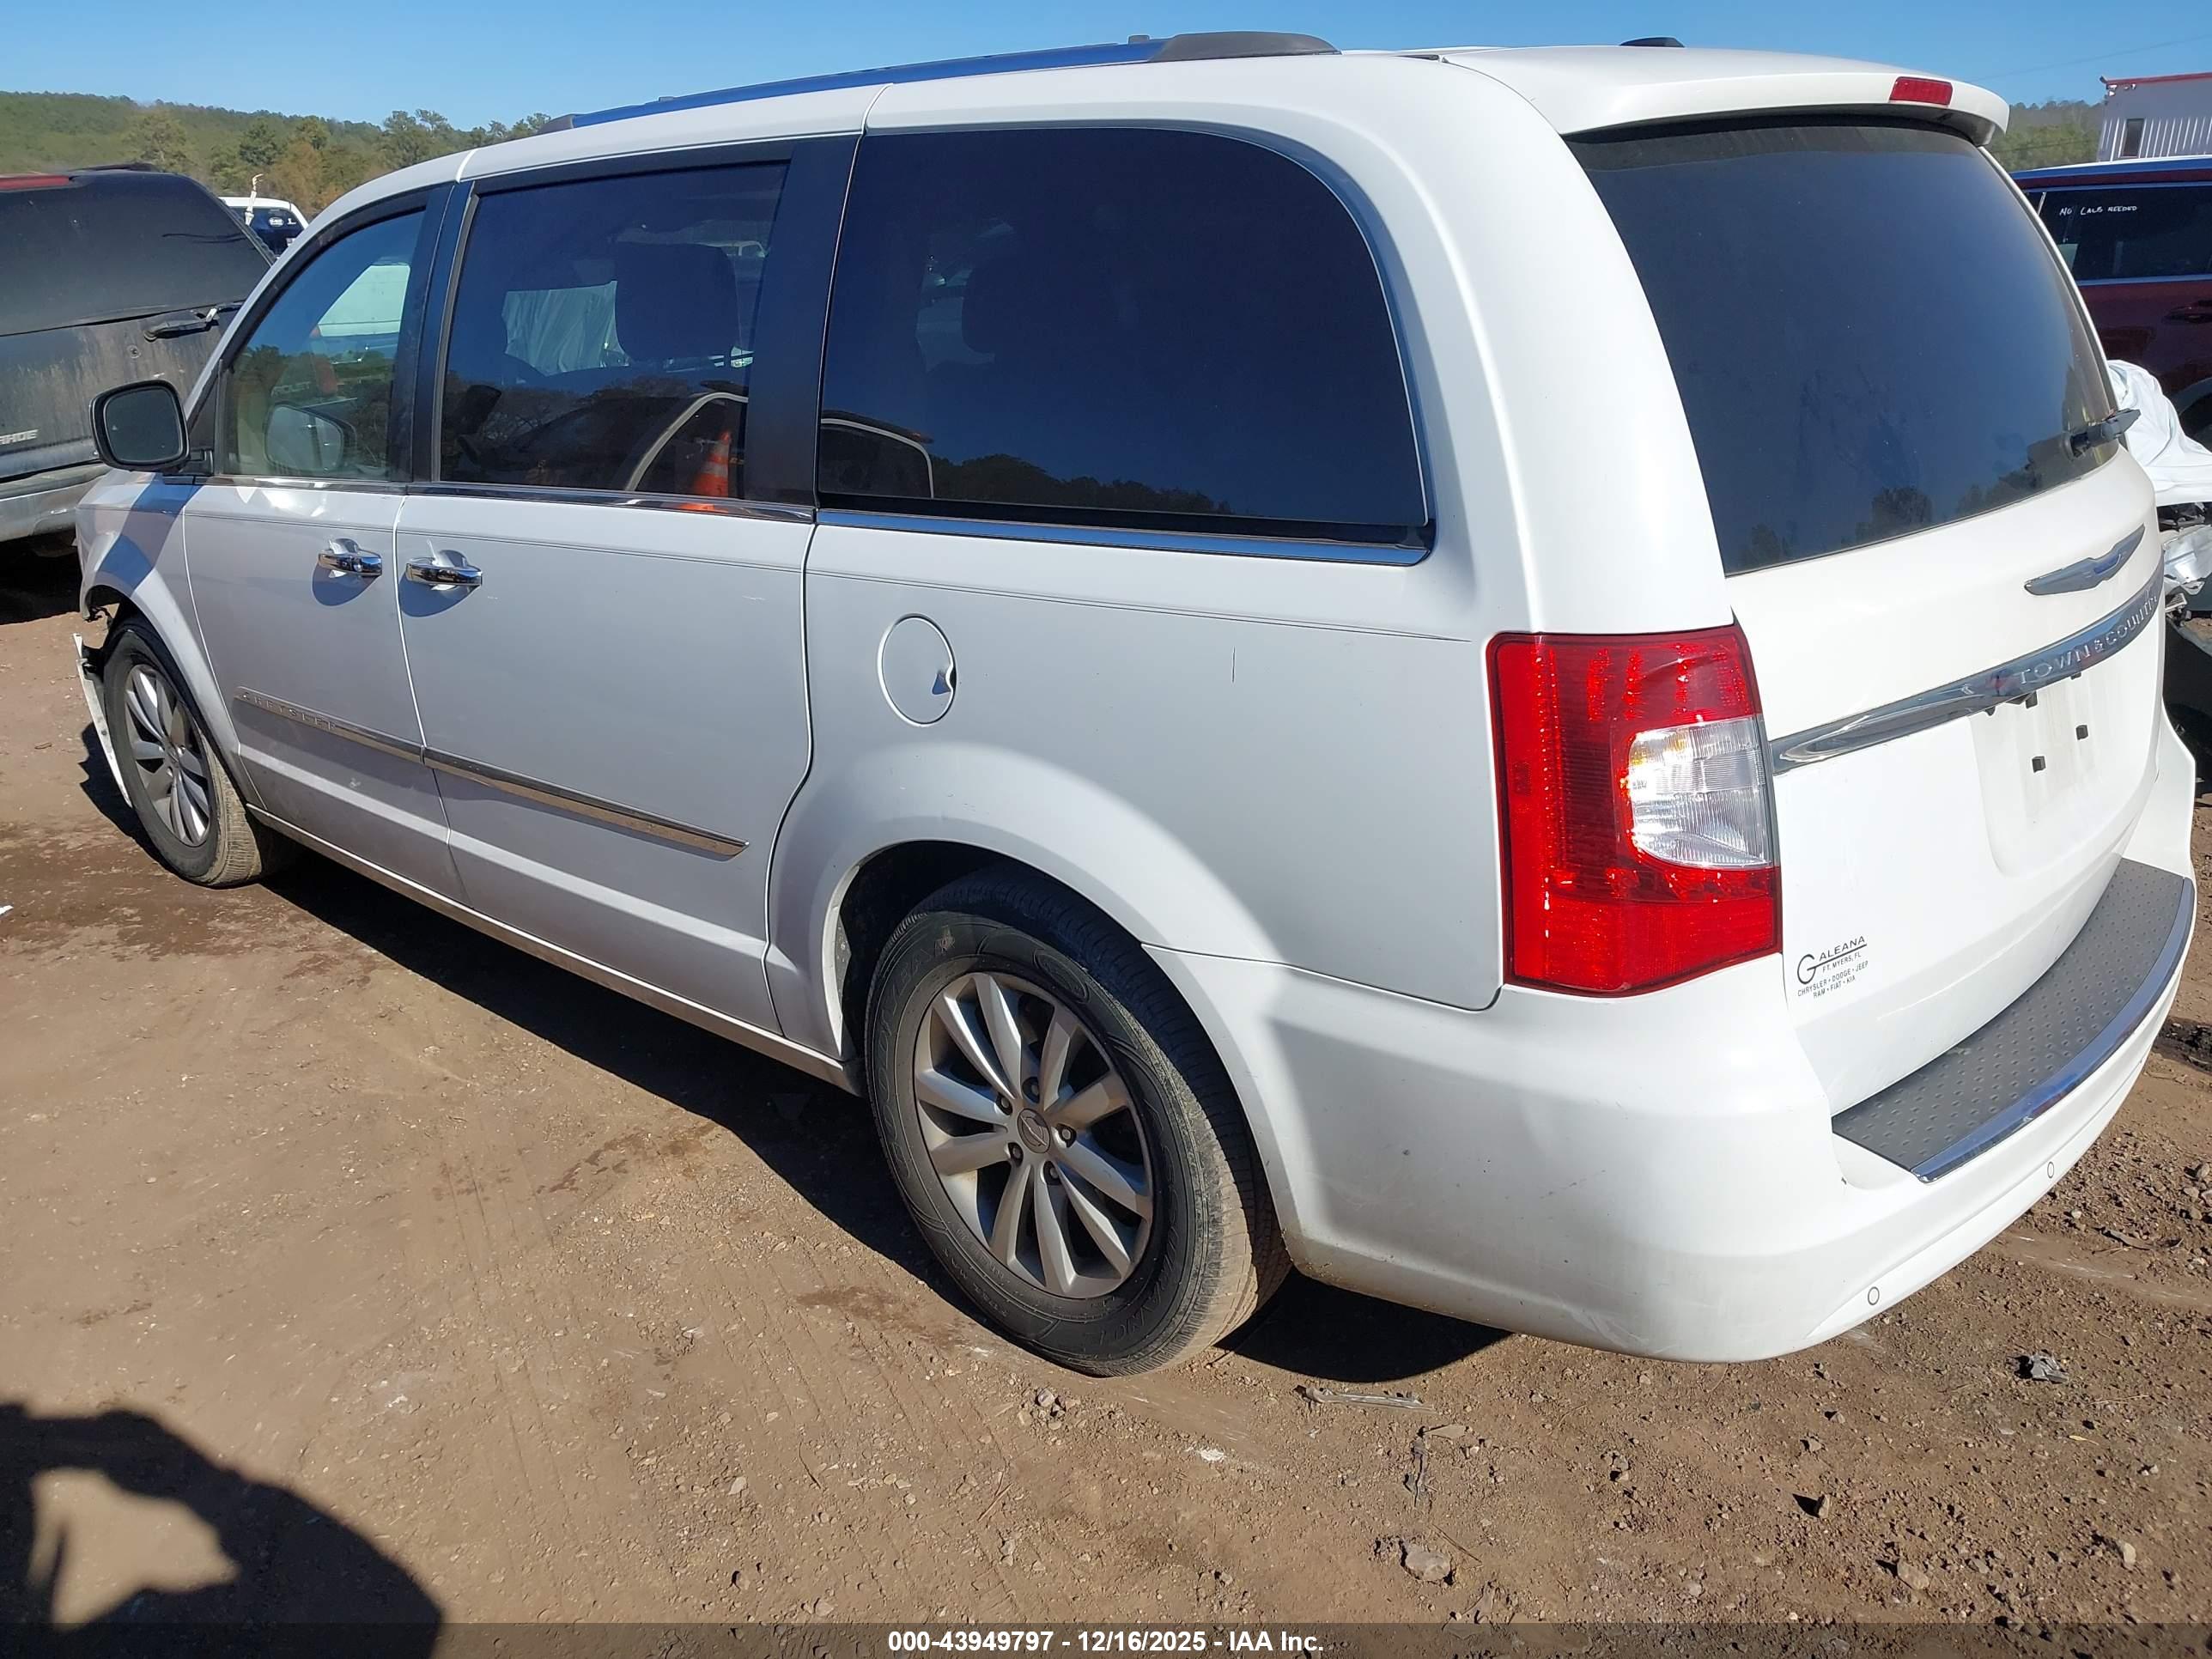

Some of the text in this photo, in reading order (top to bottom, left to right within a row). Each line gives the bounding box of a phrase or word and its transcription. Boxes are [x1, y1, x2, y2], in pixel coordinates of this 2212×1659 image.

[2059, 207, 2073, 216] NO
[1822, 964, 1832, 973] FT.
[1797, 960, 1869, 997] CHRYSLER DODGE JEEP
[1813, 988, 1826, 999] RAM
[1830, 981, 1842, 992] FIAT
